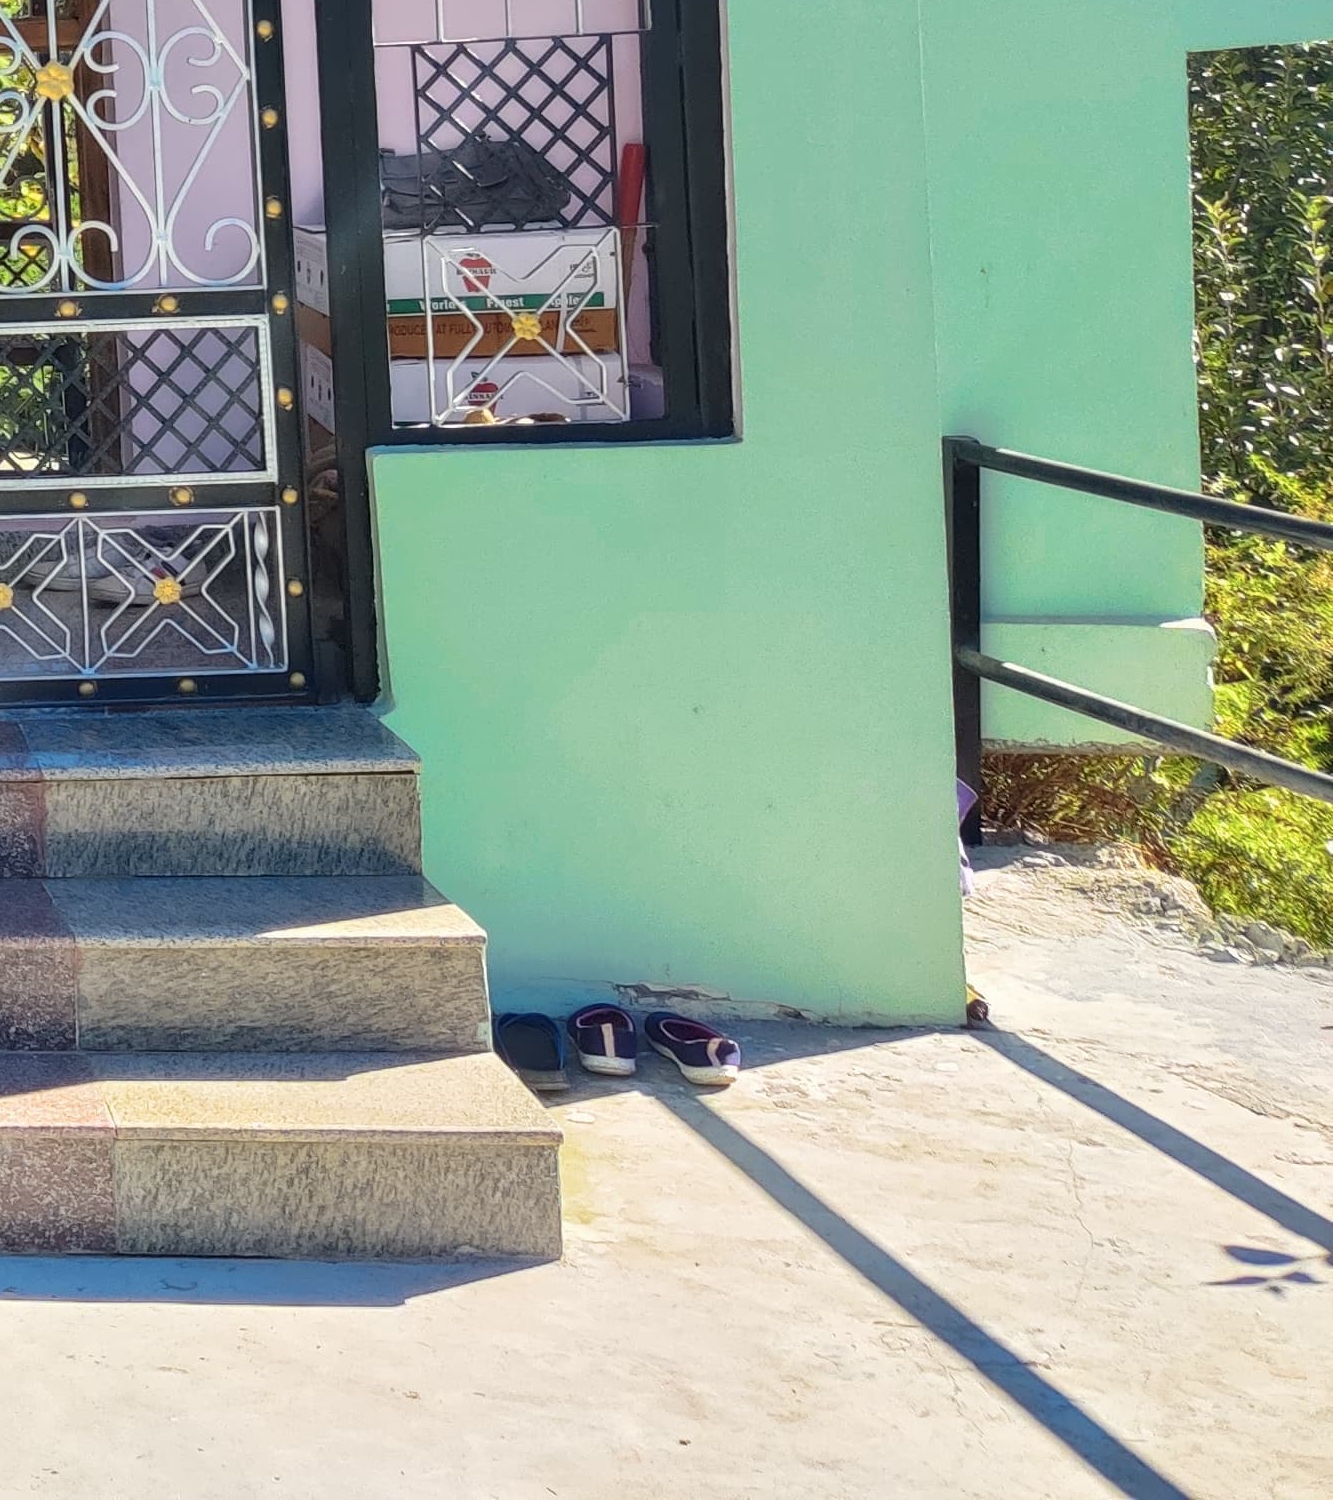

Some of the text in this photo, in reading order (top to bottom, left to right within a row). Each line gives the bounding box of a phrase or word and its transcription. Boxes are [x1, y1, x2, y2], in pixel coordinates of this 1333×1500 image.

[419, 299, 467, 312] Worlds
[486, 296, 525, 309] Fnest
[449, 322, 475, 334] FULL
